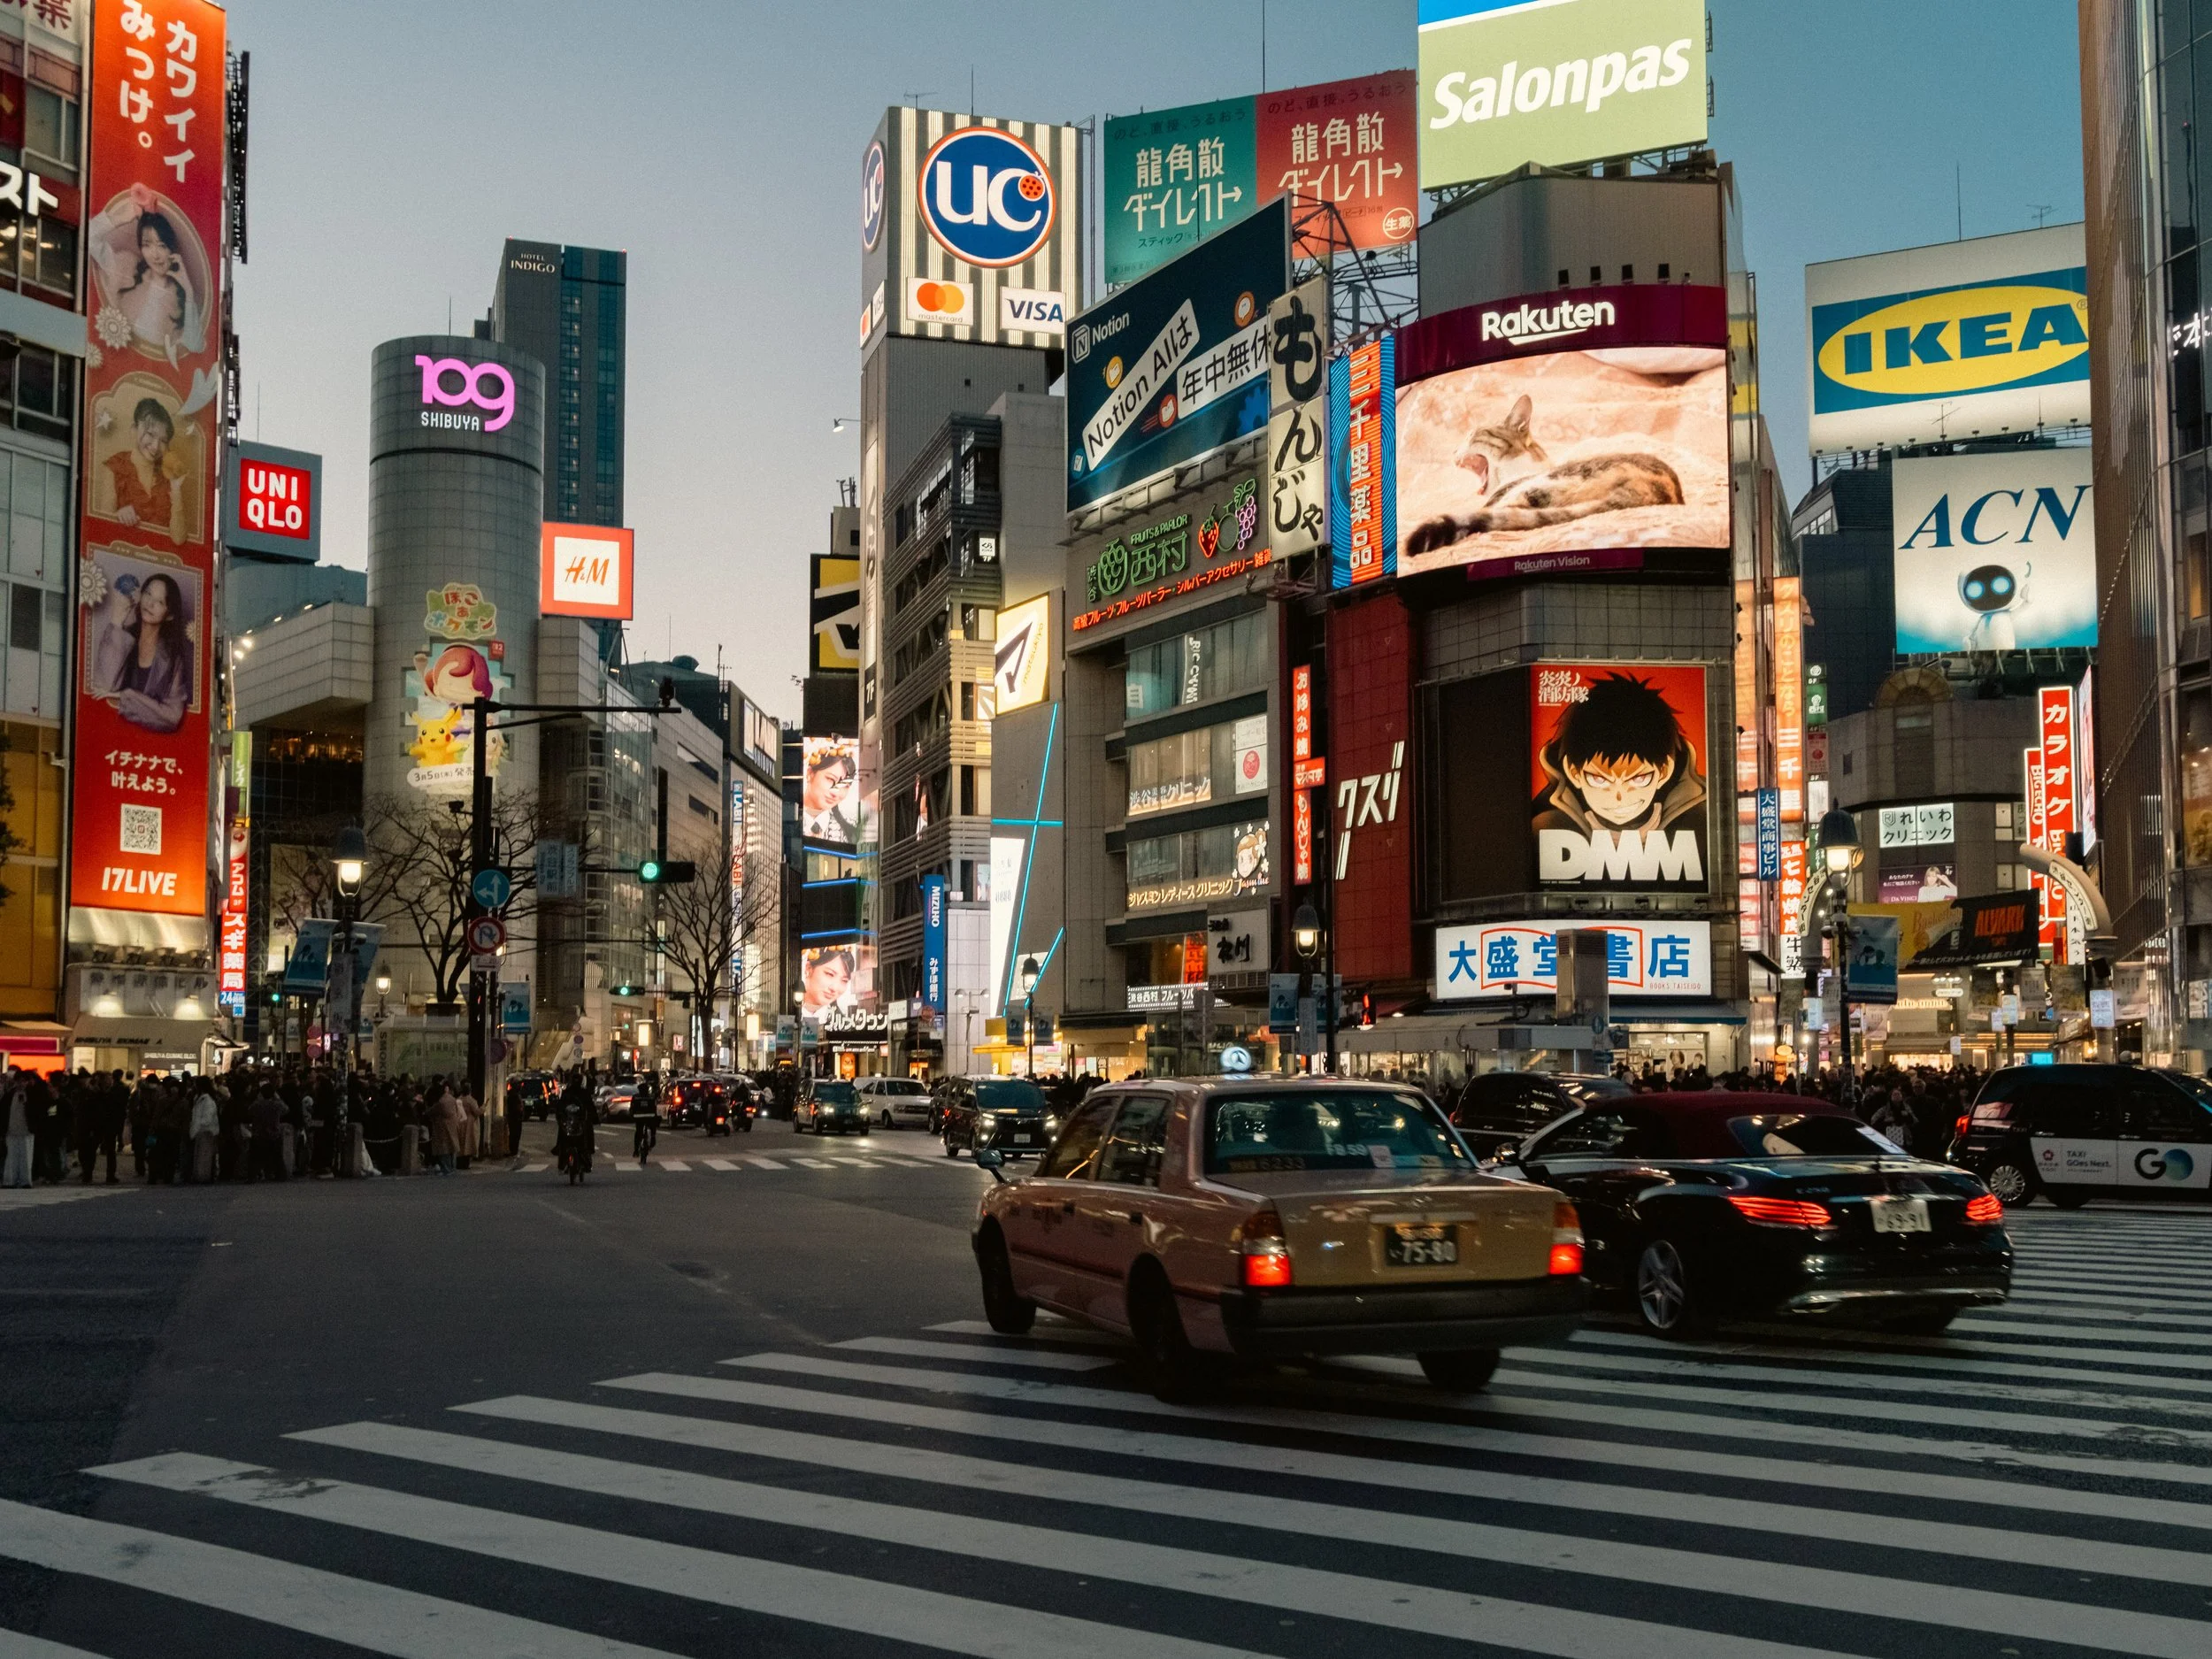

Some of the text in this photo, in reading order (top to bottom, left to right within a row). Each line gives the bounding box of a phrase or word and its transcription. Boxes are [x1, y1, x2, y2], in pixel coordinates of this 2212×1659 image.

[164, 19, 197, 183] カワイイ
[1430, 38, 1692, 129] Salonpas
[1291, 111, 1385, 165] 龍角散
[1135, 135, 1225, 189] 龍角散
[1278, 157, 1404, 207] ダイレクト
[936, 160, 1044, 233] UC
[1123, 180, 1243, 233] ダイレクト
[1137, 233, 1184, 249] スティック
[1385, 215, 1412, 232] 生薬
[511, 259, 556, 274] INDIGO
[520, 252, 545, 262] HOTEL
[918, 312, 964, 324] mastercard
[1006, 297, 1064, 323] VISA
[1092, 311, 1129, 347] Notion
[1481, 299, 1616, 343] Rakuten
[1843, 303, 2089, 375] IKEA
[1181, 320, 1271, 405] 年中無休
[415, 354, 515, 432] 109
[1272, 295, 1325, 534] もんじゃ
[420, 411, 480, 432] SHIBUYA
[1087, 375, 1148, 458] Notion
[1348, 353, 1373, 570] 三千里薬品
[248, 467, 299, 502] UNI
[247, 497, 303, 530] QLO
[1898, 484, 2093, 550] ACN
[565, 556, 611, 587] H&M
[1514, 555, 1591, 572] Rakuten Vision
[1023, 622, 1044, 685] matsukiyo
[1778, 582, 1797, 718] クスリのことなら
[1538, 686, 1589, 703] 消防隊
[1539, 670, 1581, 687] 炎炎ノ
[104, 749, 184, 775] イチナナで、
[111, 771, 177, 795] 叶えよう。
[1777, 726, 1802, 810] 三千里
[2043, 703, 2071, 819] カラオケ
[1761, 793, 1777, 876] 大盛堂商事ビル
[1883, 826, 1952, 844] クリニック
[1900, 808, 1952, 826] れいわ
[1539, 829, 1704, 880] DMM
[102, 866, 178, 897] 17LIVE
[232, 862, 246, 897] アコム
[929, 887, 941, 927] MIZUHO
[223, 909, 247, 989] スギ薬局
[929, 957, 939, 1002] みずほ銀行
[825, 1004, 888, 1032] グルメタウン
